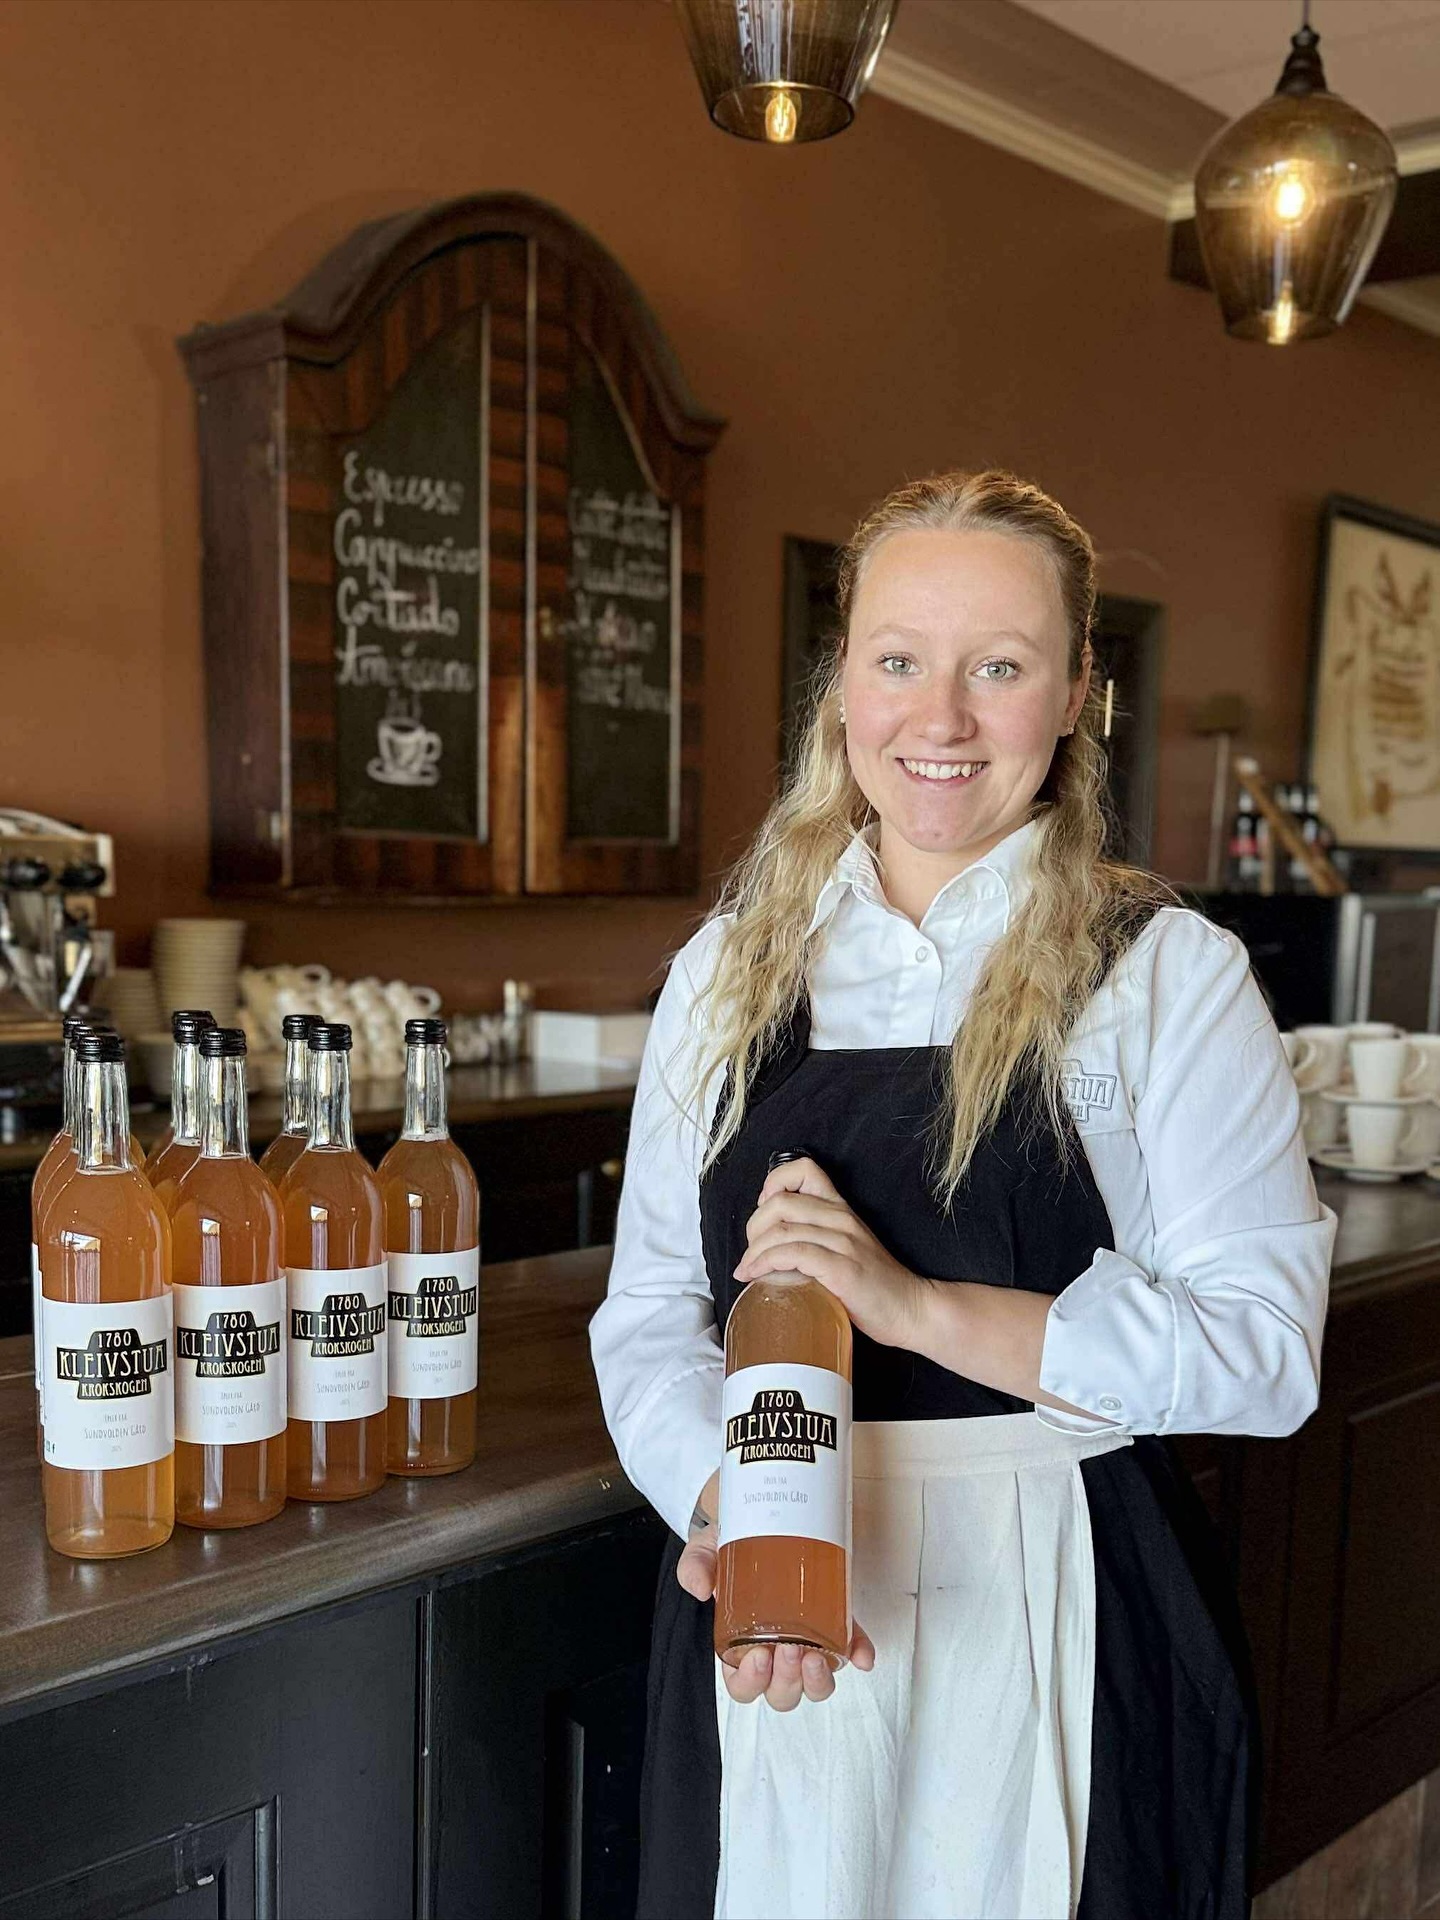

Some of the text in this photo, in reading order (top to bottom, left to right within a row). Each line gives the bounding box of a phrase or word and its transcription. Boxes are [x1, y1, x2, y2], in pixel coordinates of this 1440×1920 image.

[426, 1278, 453, 1293] 1780
[331, 1295, 360, 1311] 1780
[392, 1290, 476, 1319] KLEIVSTUA
[216, 1313, 247, 1329] 1780
[295, 1307, 384, 1338] KLEIVSTUA
[410, 1320, 464, 1335] KROKSKOGEN
[98, 1331, 131, 1348] 1780
[180, 1327, 278, 1357] KLEIVSTUA
[315, 1338, 372, 1355] KROKSKOGEN
[59, 1345, 165, 1378] KLEIVSTUA
[200, 1359, 262, 1375] KROKSKOGEN
[81, 1378, 148, 1397] KROKSKOGEN
[761, 1392, 794, 1409] 1780
[728, 1412, 833, 1447] KLEIVSTUA
[744, 1443, 811, 1460] KROKSKOGEN
